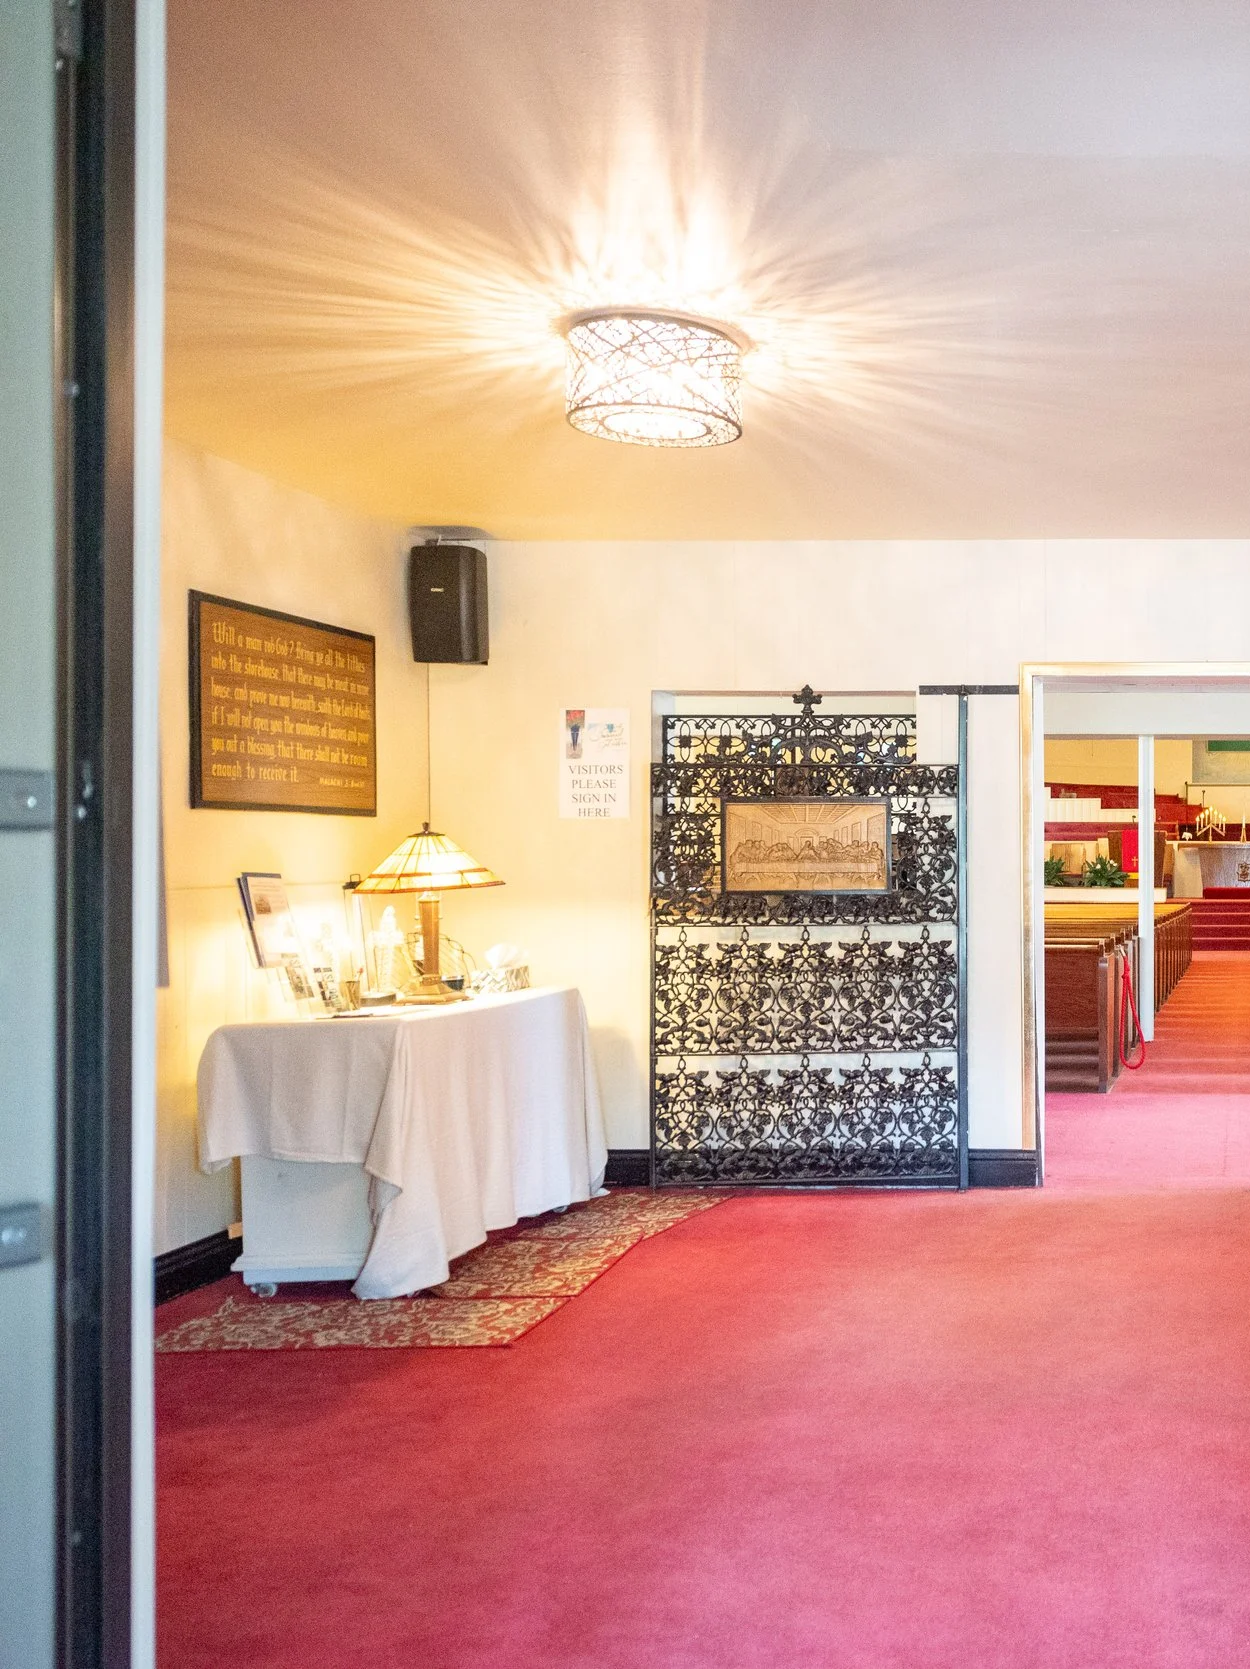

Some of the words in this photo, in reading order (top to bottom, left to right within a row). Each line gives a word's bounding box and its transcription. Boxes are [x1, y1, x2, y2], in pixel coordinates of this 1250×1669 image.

[212, 621, 235, 646] Will
[246, 762, 255, 780] to
[259, 765, 287, 782] receive
[568, 764, 624, 775] VISITORS
[571, 779, 617, 789] PLEASE
[571, 793, 600, 804] SIGN
[604, 793, 617, 803] IN
[578, 807, 611, 817] HERE
